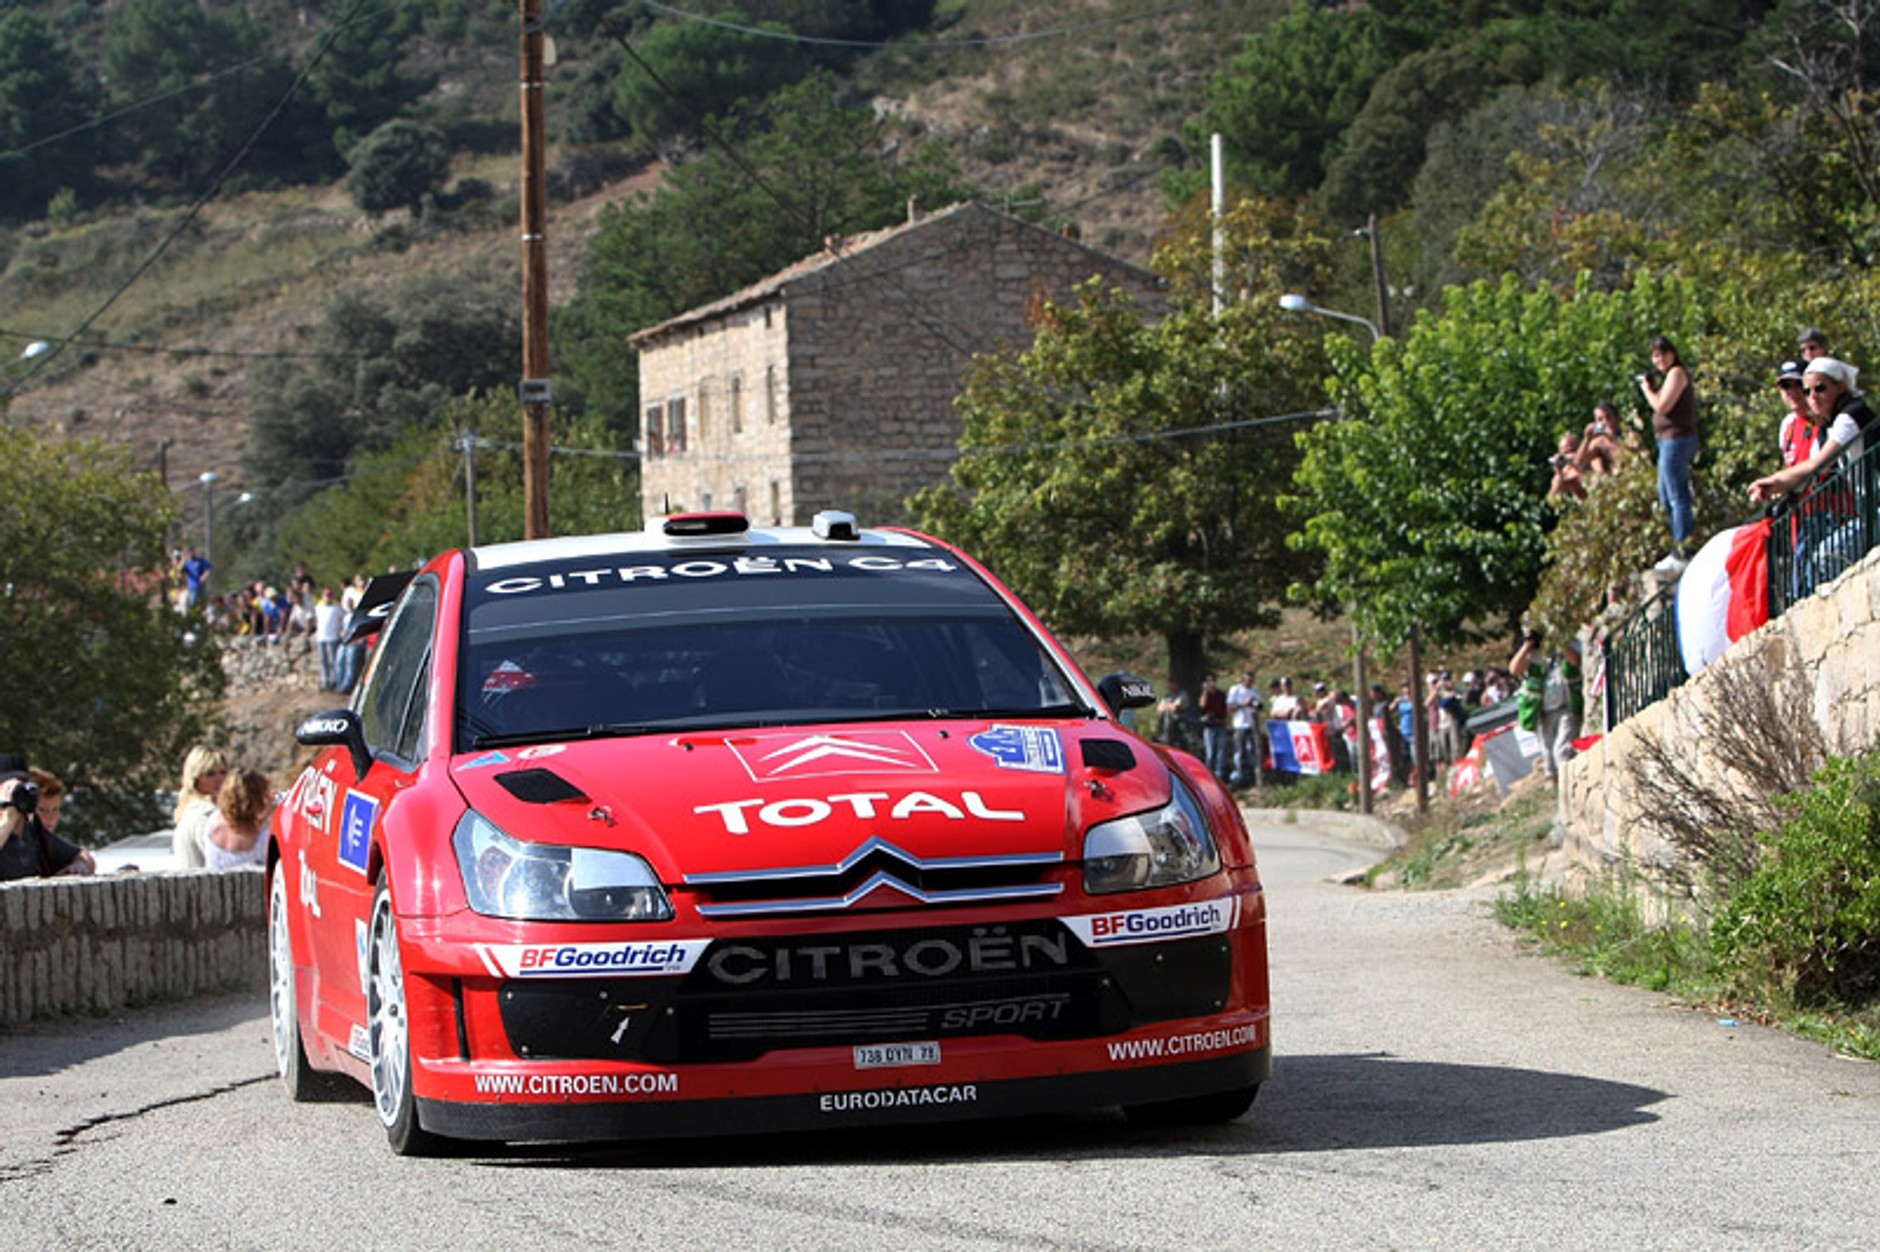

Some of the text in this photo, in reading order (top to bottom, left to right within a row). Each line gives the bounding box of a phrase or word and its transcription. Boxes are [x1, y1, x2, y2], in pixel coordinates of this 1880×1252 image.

[484, 555, 958, 593] CITROËN C4
[693, 791, 1026, 835] TOTAL
[1091, 904, 1221, 937] BFGoodrich
[520, 943, 687, 968] BFGoodrich
[707, 925, 1069, 984] CITROËN
[941, 999, 1071, 1030] SPORT
[1107, 1024, 1256, 1061] WWW.CITROEN.COM
[475, 1073, 678, 1095] WWW.CITROEN.COM
[820, 1085, 977, 1111] EURODATACAR
